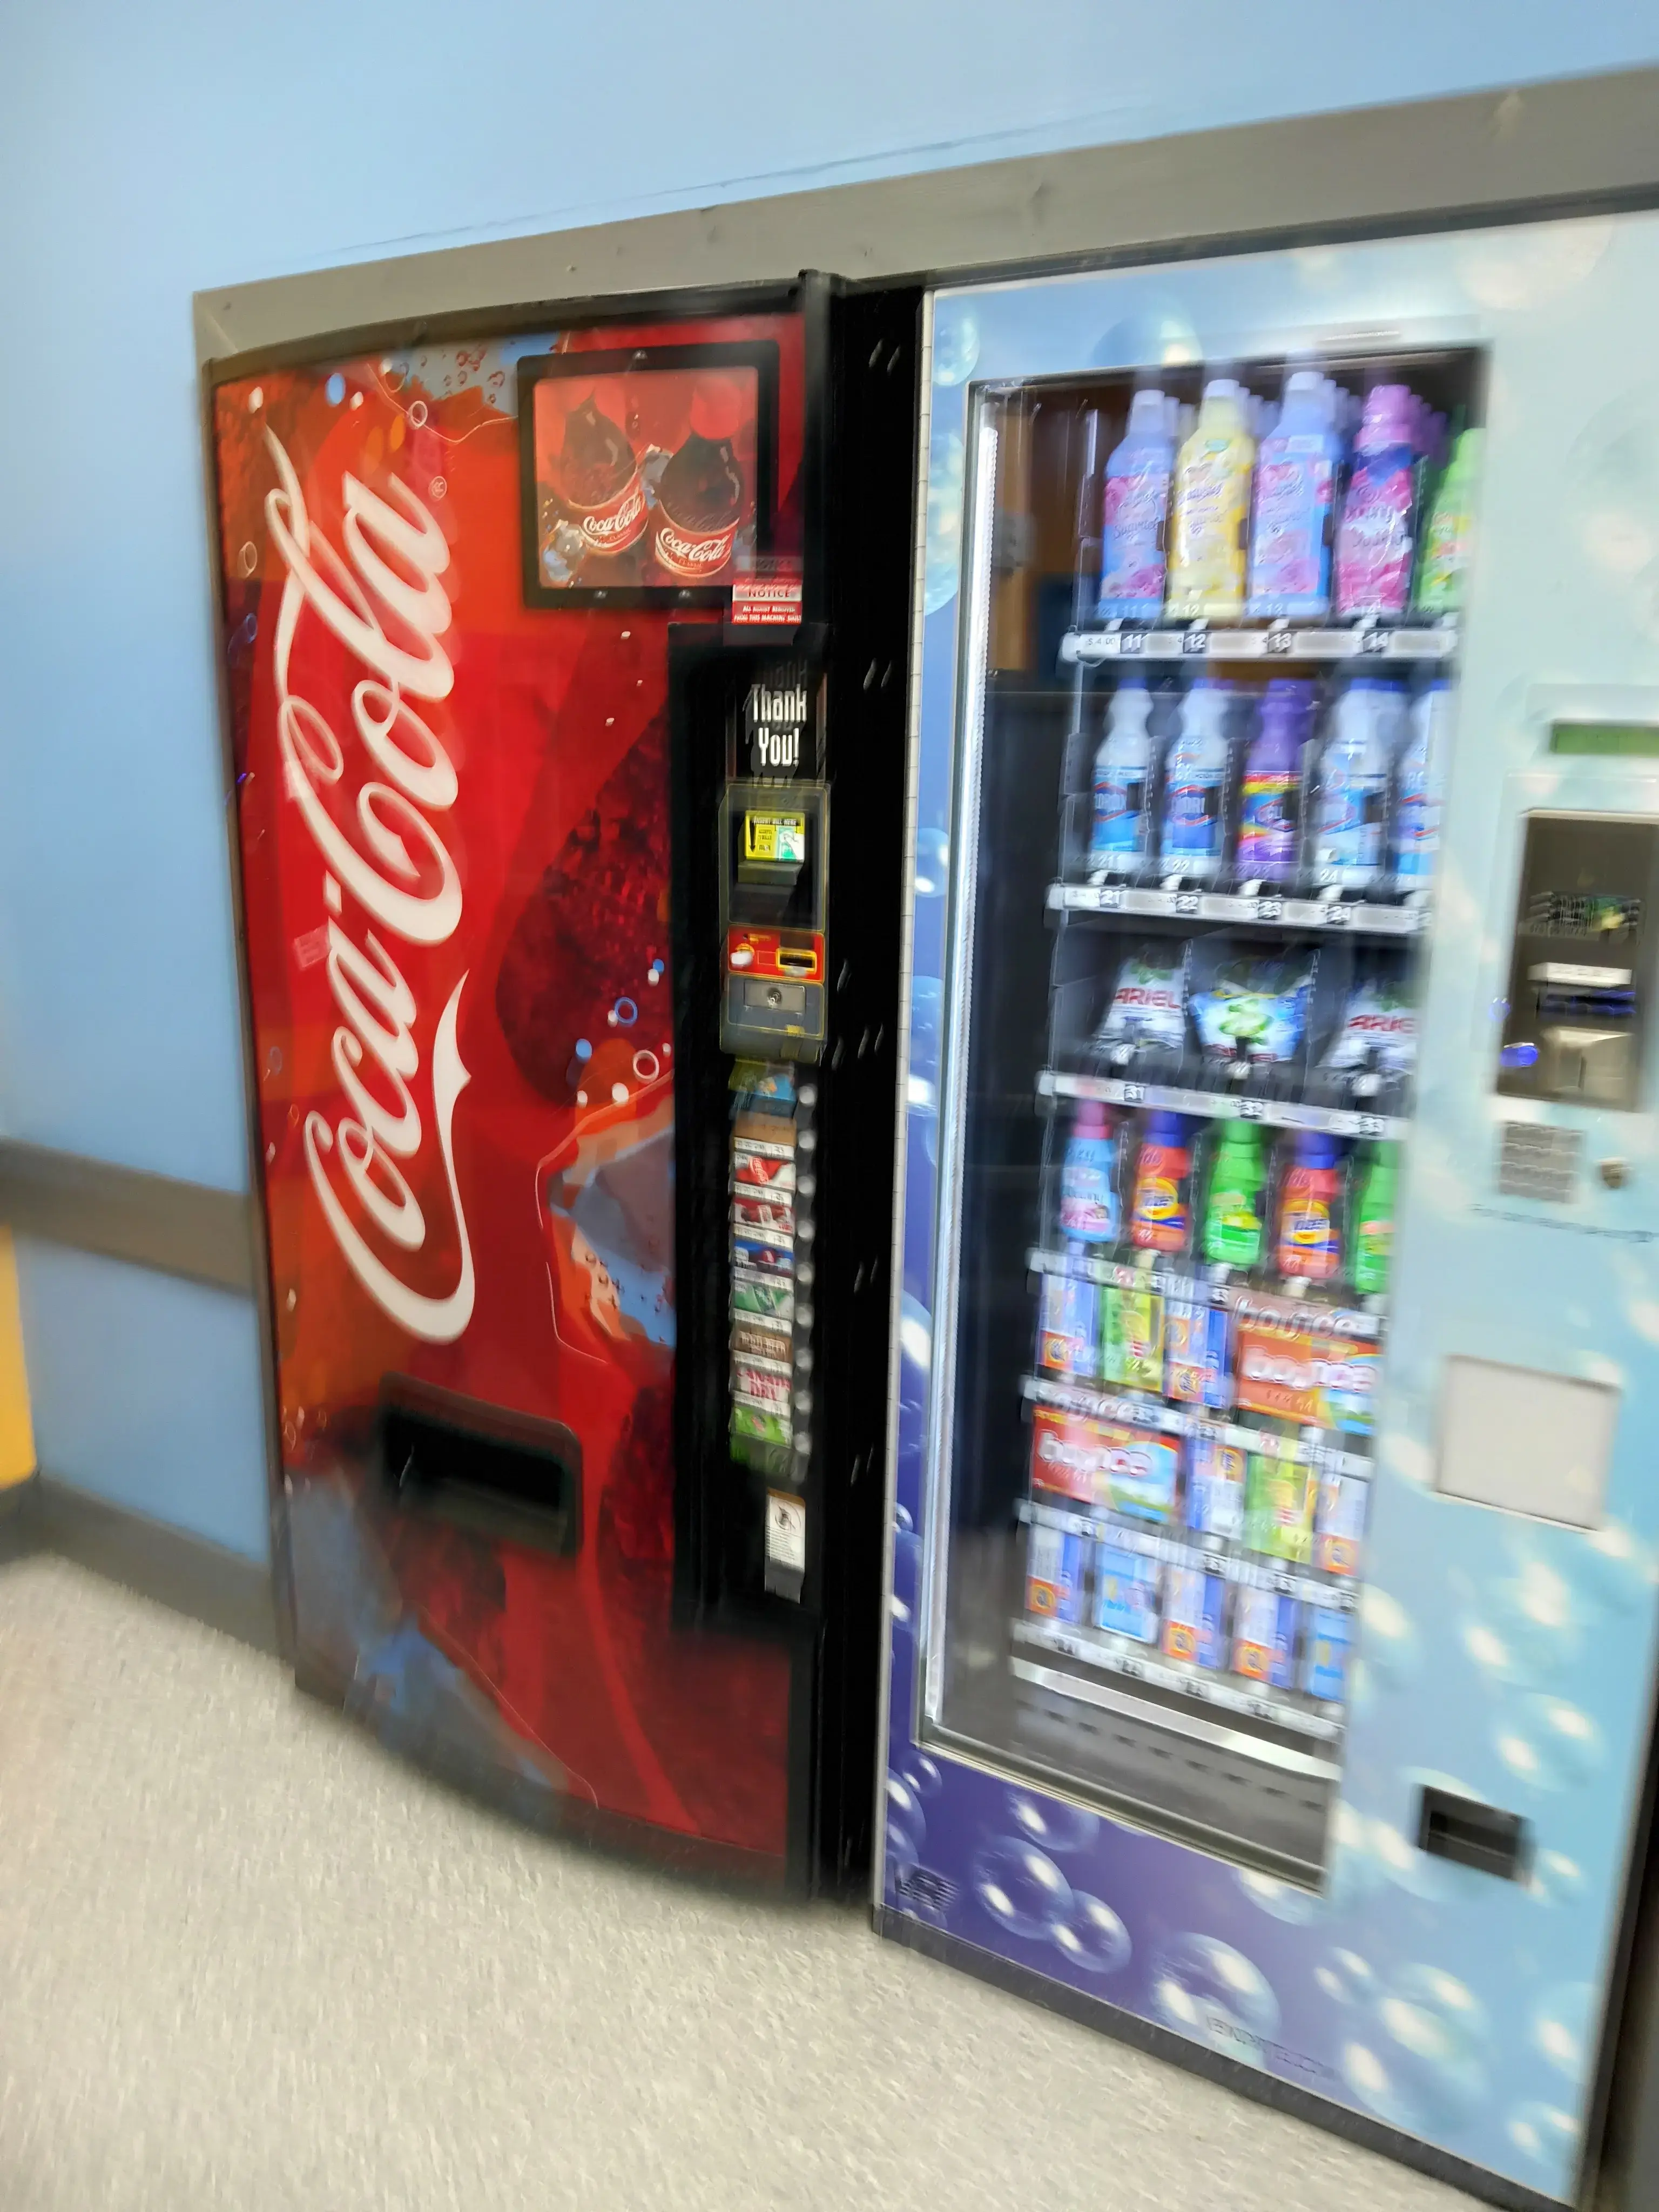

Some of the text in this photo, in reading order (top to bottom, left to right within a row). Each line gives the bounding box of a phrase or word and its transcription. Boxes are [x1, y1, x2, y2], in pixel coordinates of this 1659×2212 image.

[583, 494, 641, 535] Coca-Cola
[660, 528, 731, 562] Coca-Cola
[748, 588, 790, 598] NOTICE
[1184, 633, 1206, 651] 12
[751, 684, 807, 722] Thank
[759, 727, 799, 766] You!
[264, 424, 474, 1345] Coca-Cola
[1176, 895, 1198, 911] 22
